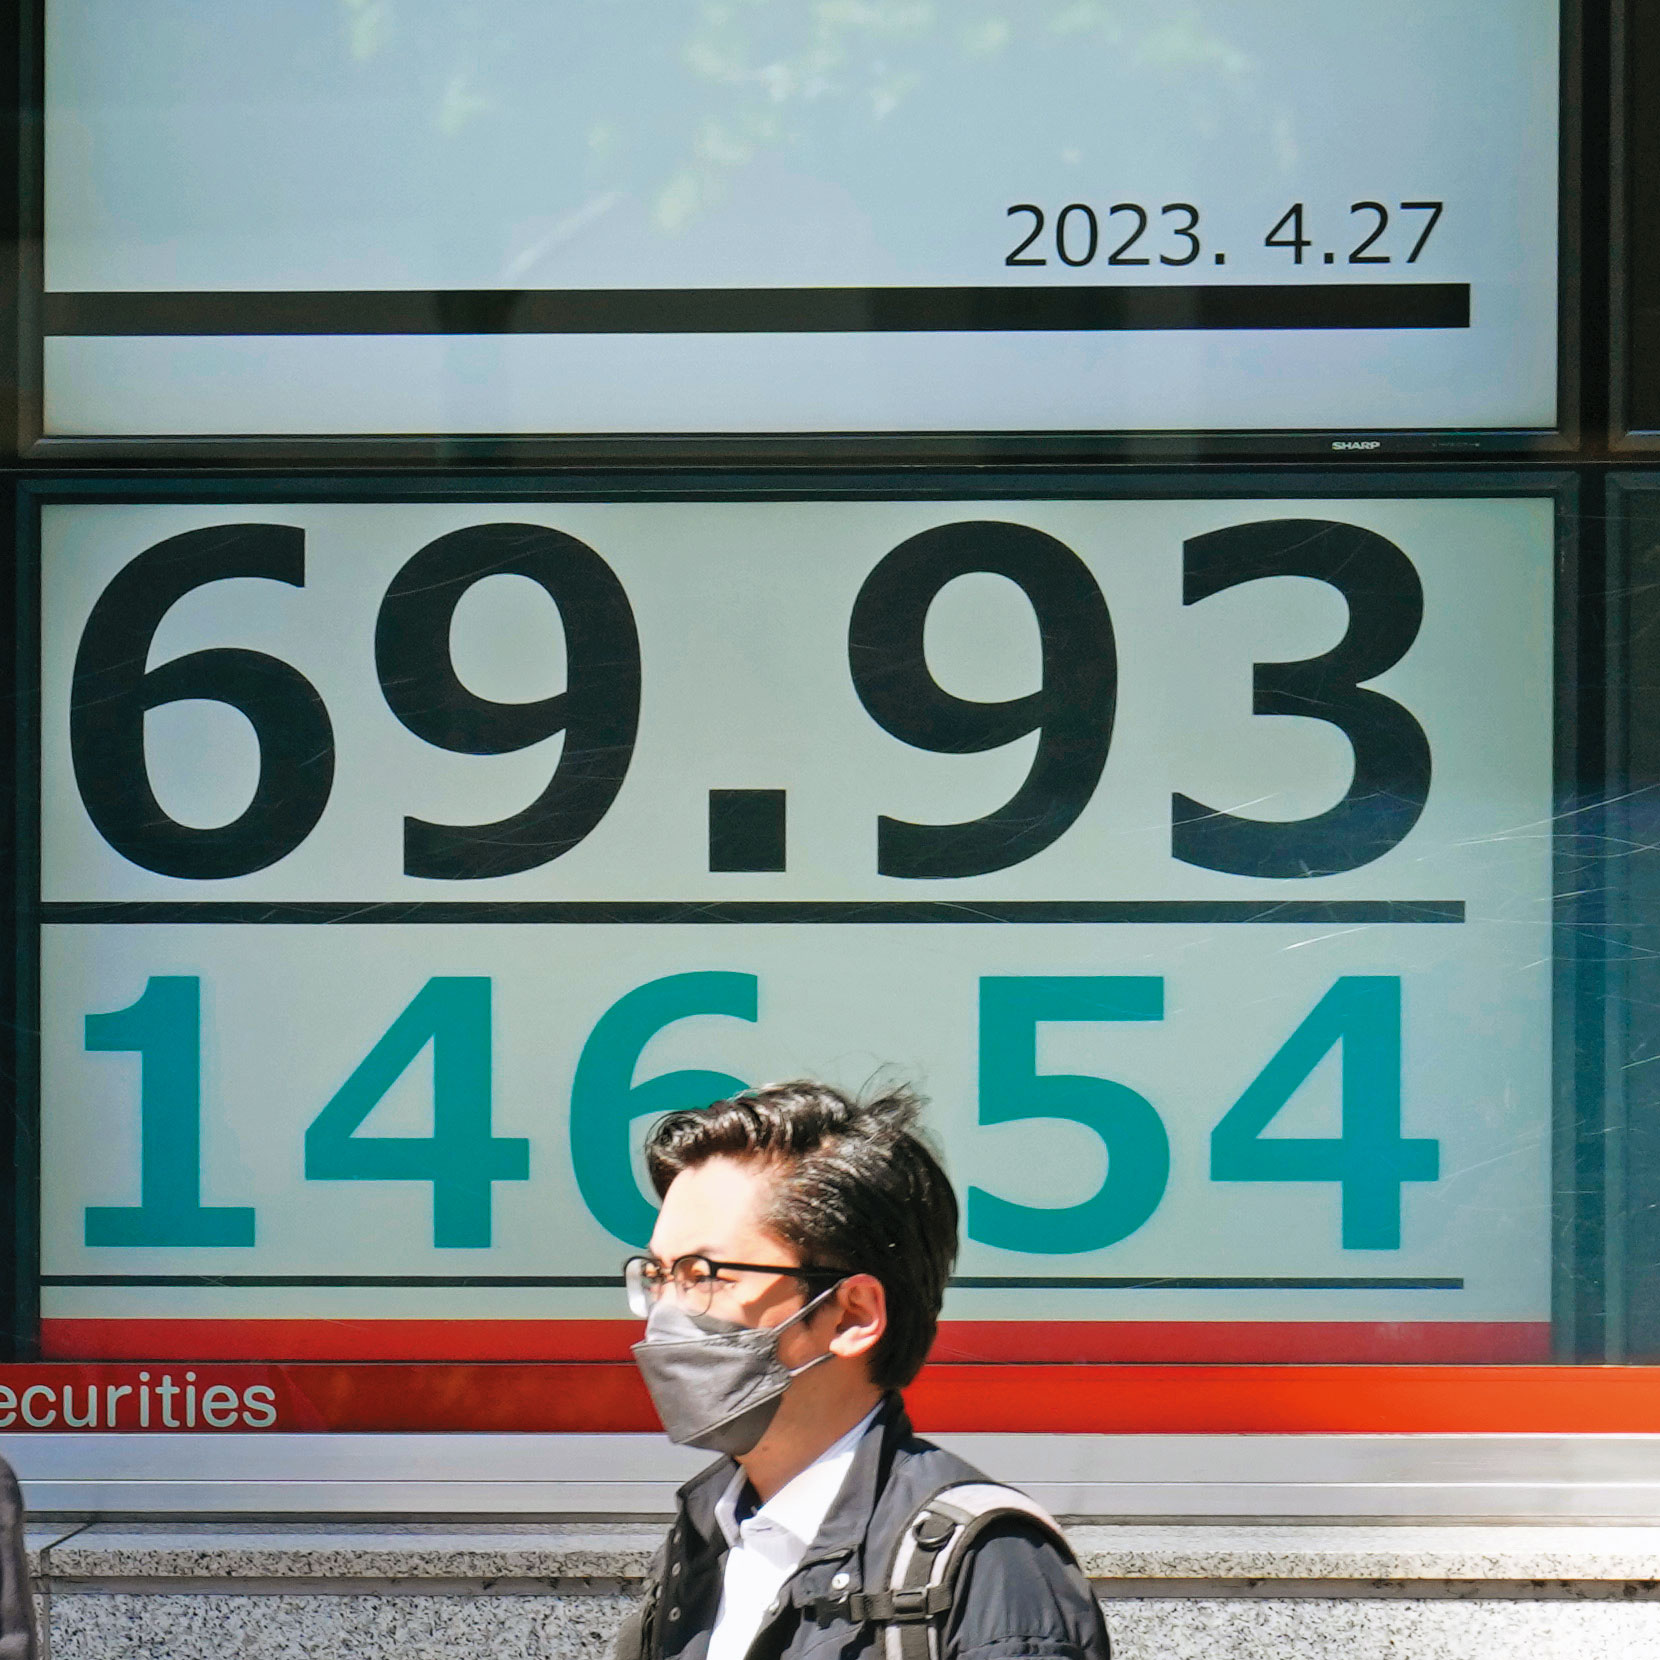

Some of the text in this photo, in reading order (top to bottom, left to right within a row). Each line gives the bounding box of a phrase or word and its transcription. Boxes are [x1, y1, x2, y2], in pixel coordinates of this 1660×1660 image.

[1004, 200, 1444, 268] 2023. 4.27
[1331, 441, 1380, 450] SHARP
[82, 970, 1441, 1255] 14654
